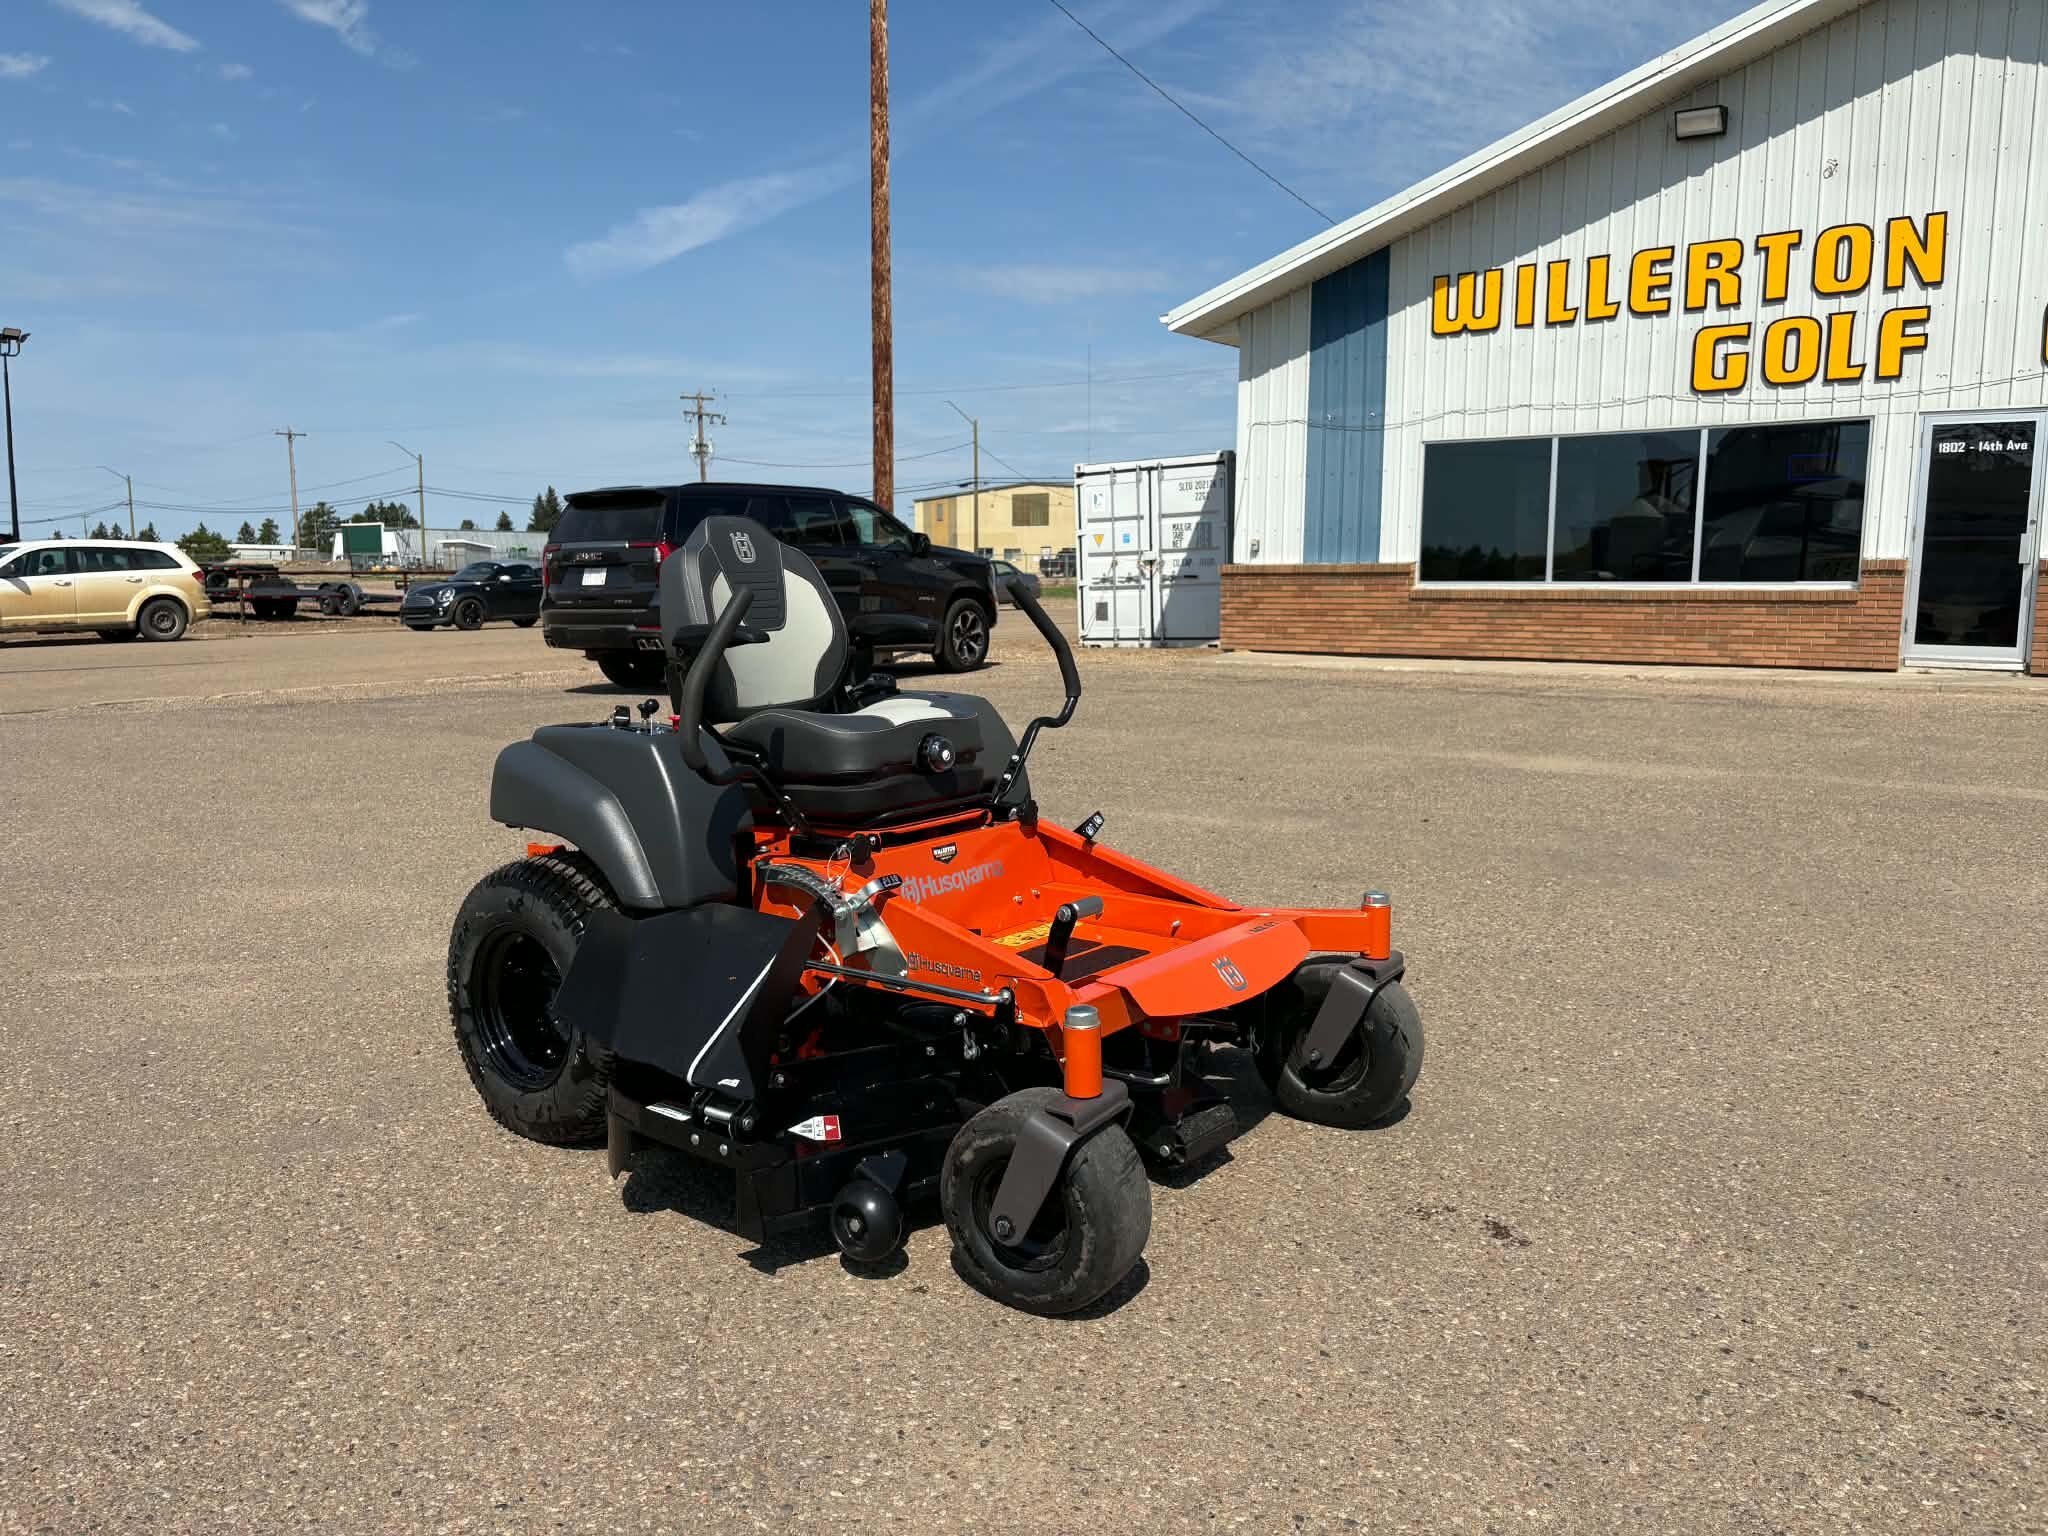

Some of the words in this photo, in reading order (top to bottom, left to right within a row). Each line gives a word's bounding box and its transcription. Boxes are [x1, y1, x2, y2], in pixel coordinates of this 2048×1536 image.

[1431, 211, 1948, 337] WILLERTON
[1691, 305, 1931, 393] GOLF
[1938, 442, 1966, 453] 1802
[1979, 440, 2003, 452] 14th
[2006, 440, 2029, 450] Ave
[920, 859, 1005, 900] Husqvarna
[921, 956, 982, 982] Husqvarna
